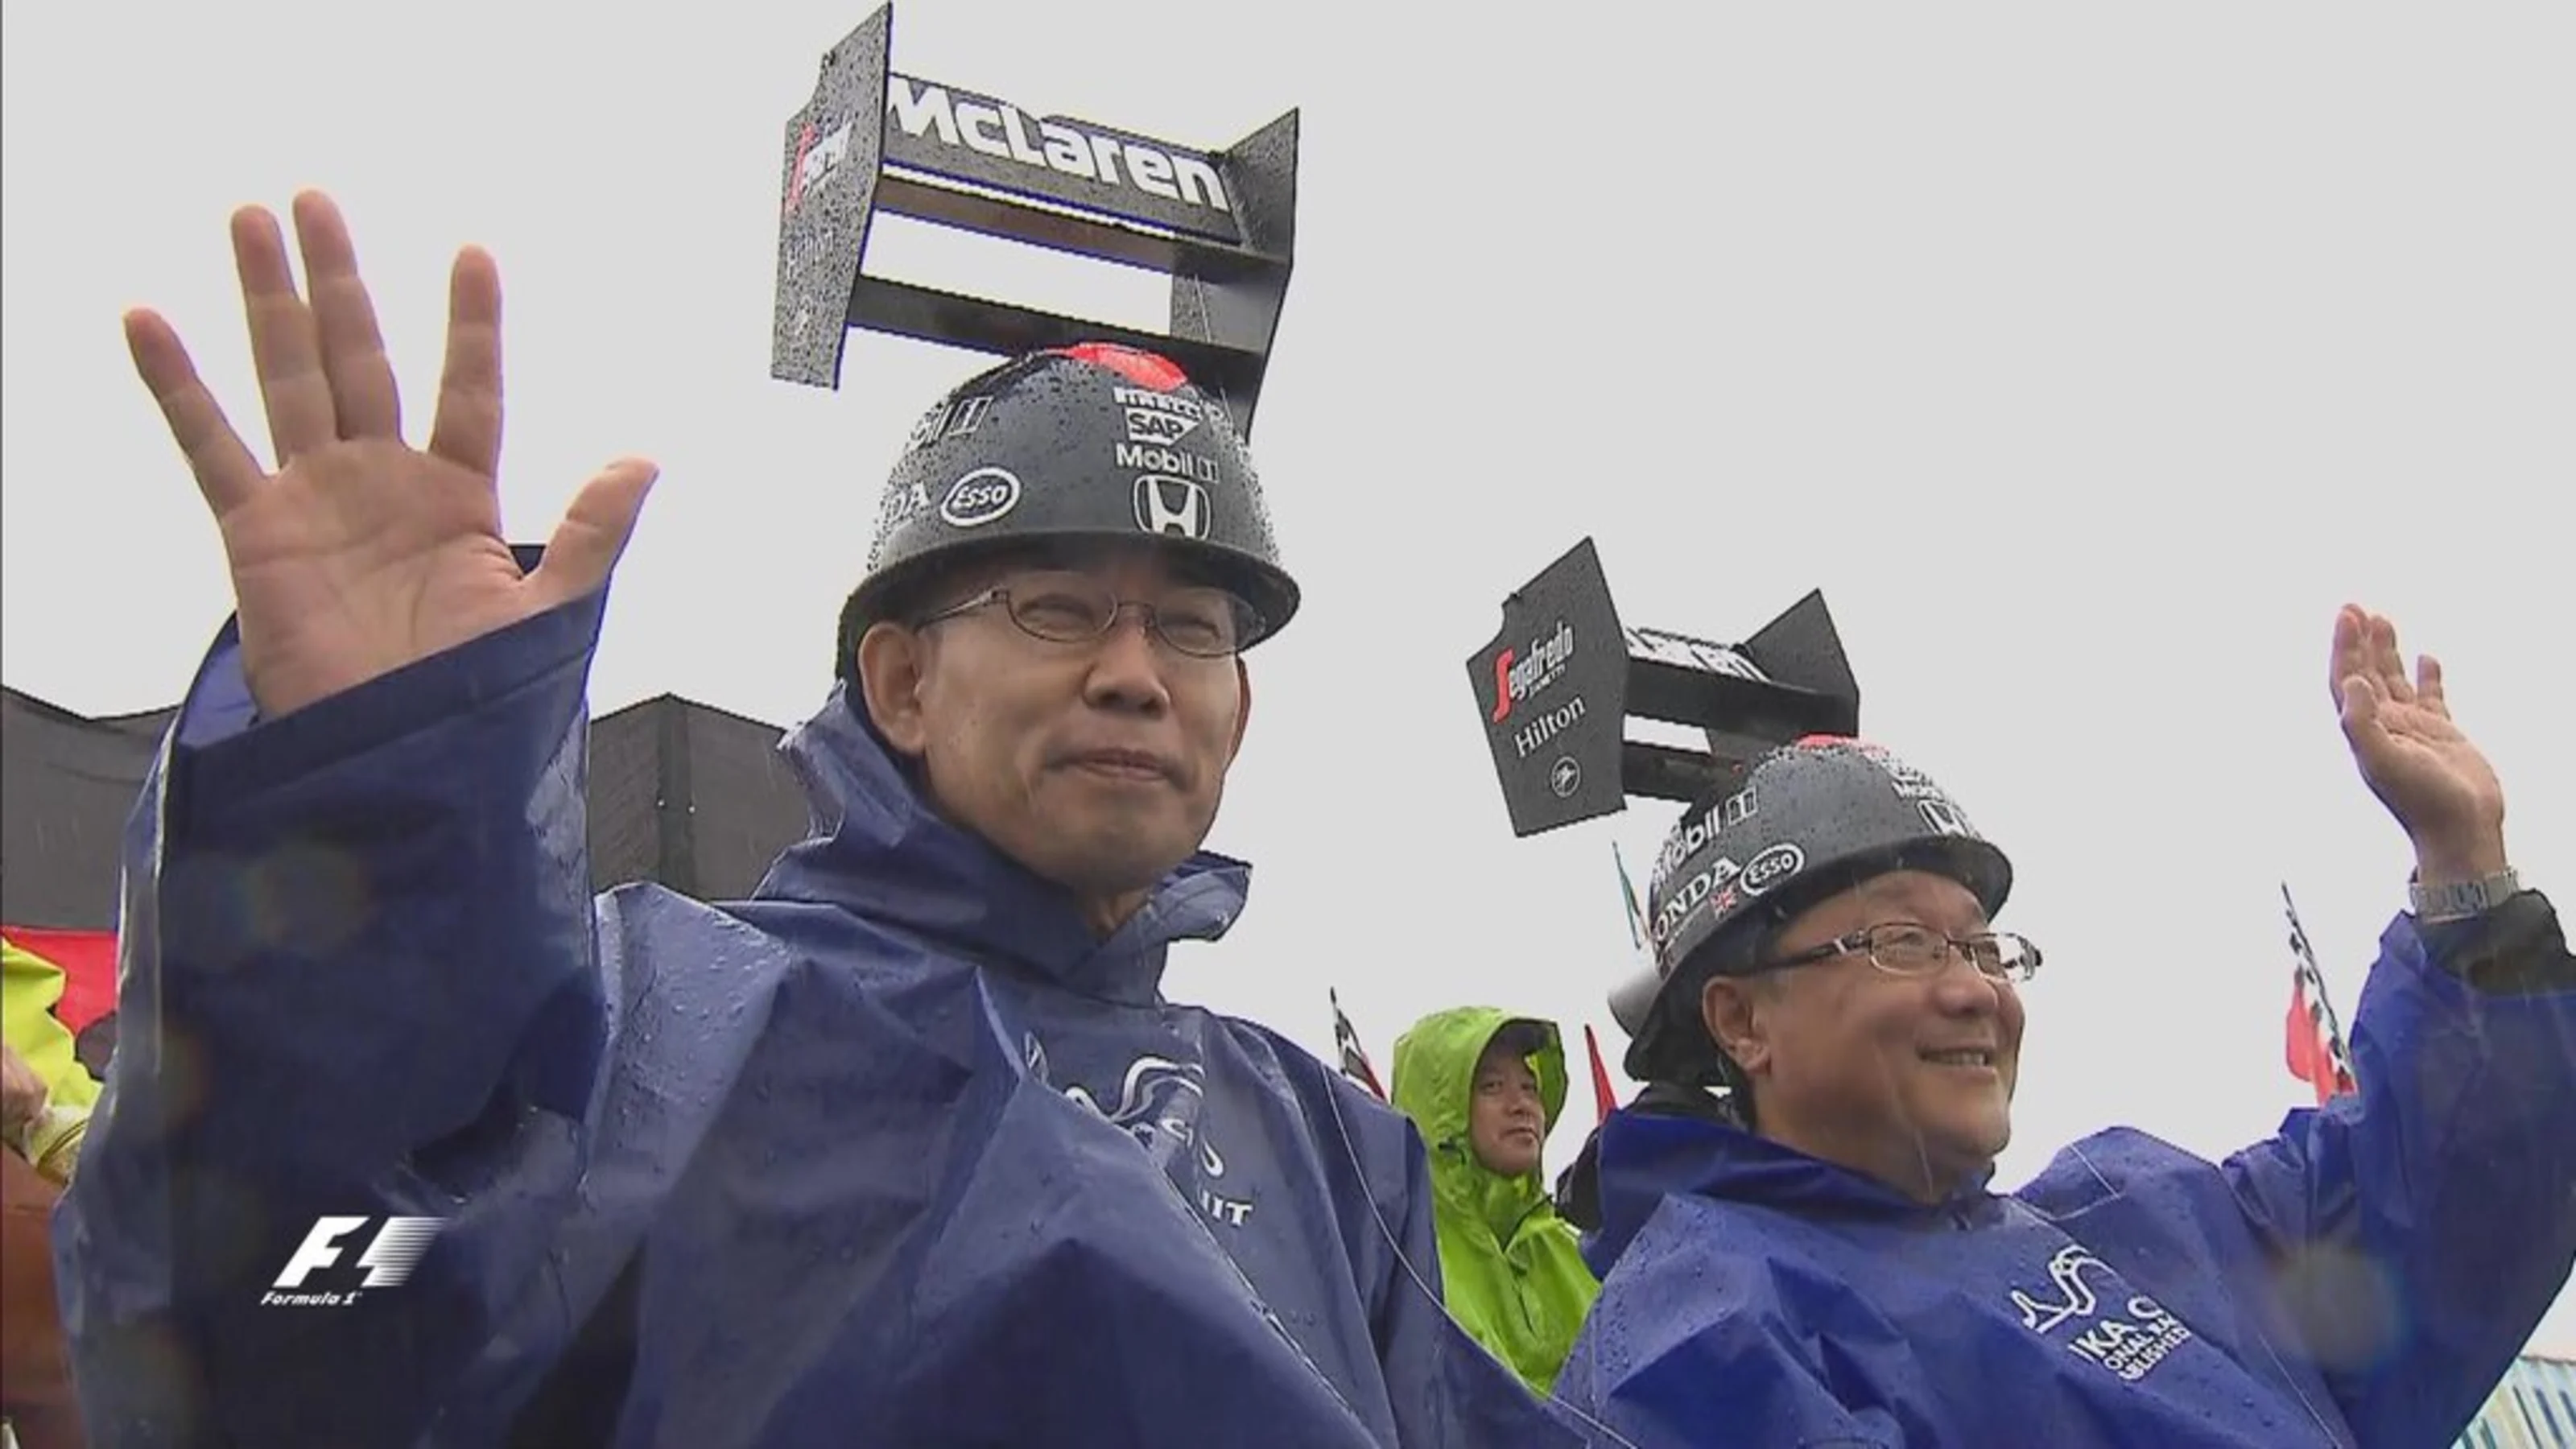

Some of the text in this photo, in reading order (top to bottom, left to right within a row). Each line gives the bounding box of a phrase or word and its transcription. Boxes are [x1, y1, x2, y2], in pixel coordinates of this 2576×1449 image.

[887, 74, 1231, 213] McLaren
[1115, 442, 1193, 477] Mobil
[1129, 411, 1183, 439] SAP
[1492, 618, 1574, 724] Segafredo
[1514, 696, 1587, 758] Hilton
[1655, 856, 1741, 952] ONDA
